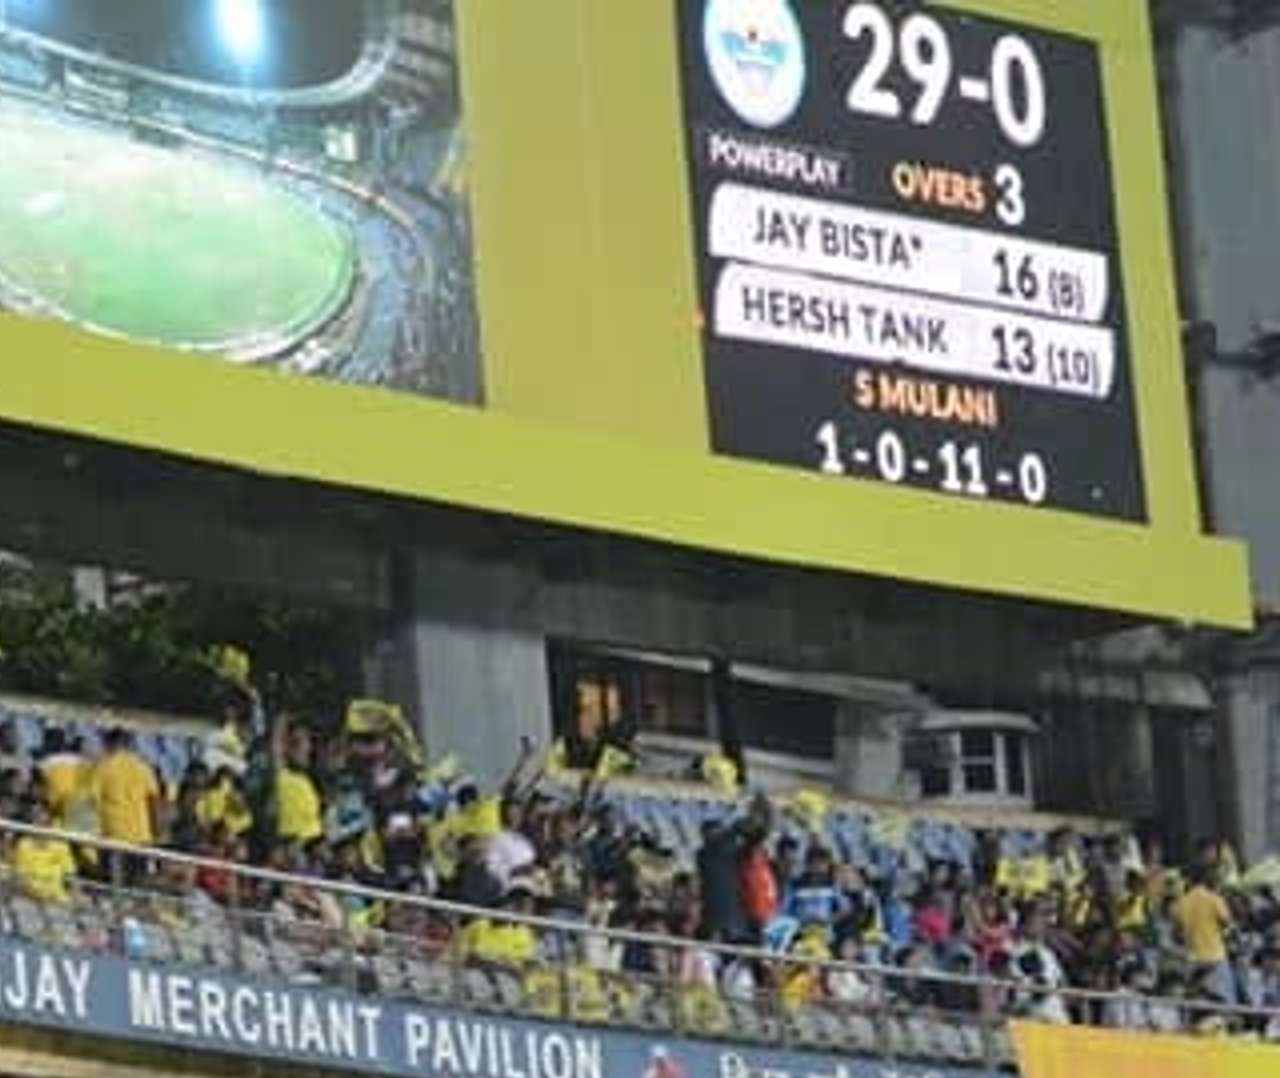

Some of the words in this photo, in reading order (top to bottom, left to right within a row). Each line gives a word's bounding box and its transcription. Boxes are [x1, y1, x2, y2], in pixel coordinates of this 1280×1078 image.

[843, 4, 1045, 147] 29-0
[709, 134, 839, 187] POWERPLAY
[892, 162, 985, 211] OVERS
[994, 164, 1025, 224] 3
[751, 206, 808, 252] JAY
[993, 248, 1039, 302] 16
[1047, 270, 1084, 313] (8)
[742, 287, 850, 340] HERSH
[858, 308, 947, 356] TANK
[992, 326, 1037, 375] 13
[1046, 346, 1099, 390] (10)
[854, 371, 875, 406] S
[880, 377, 996, 427] MULANI
[127, 968, 383, 1059] MERCHANT
